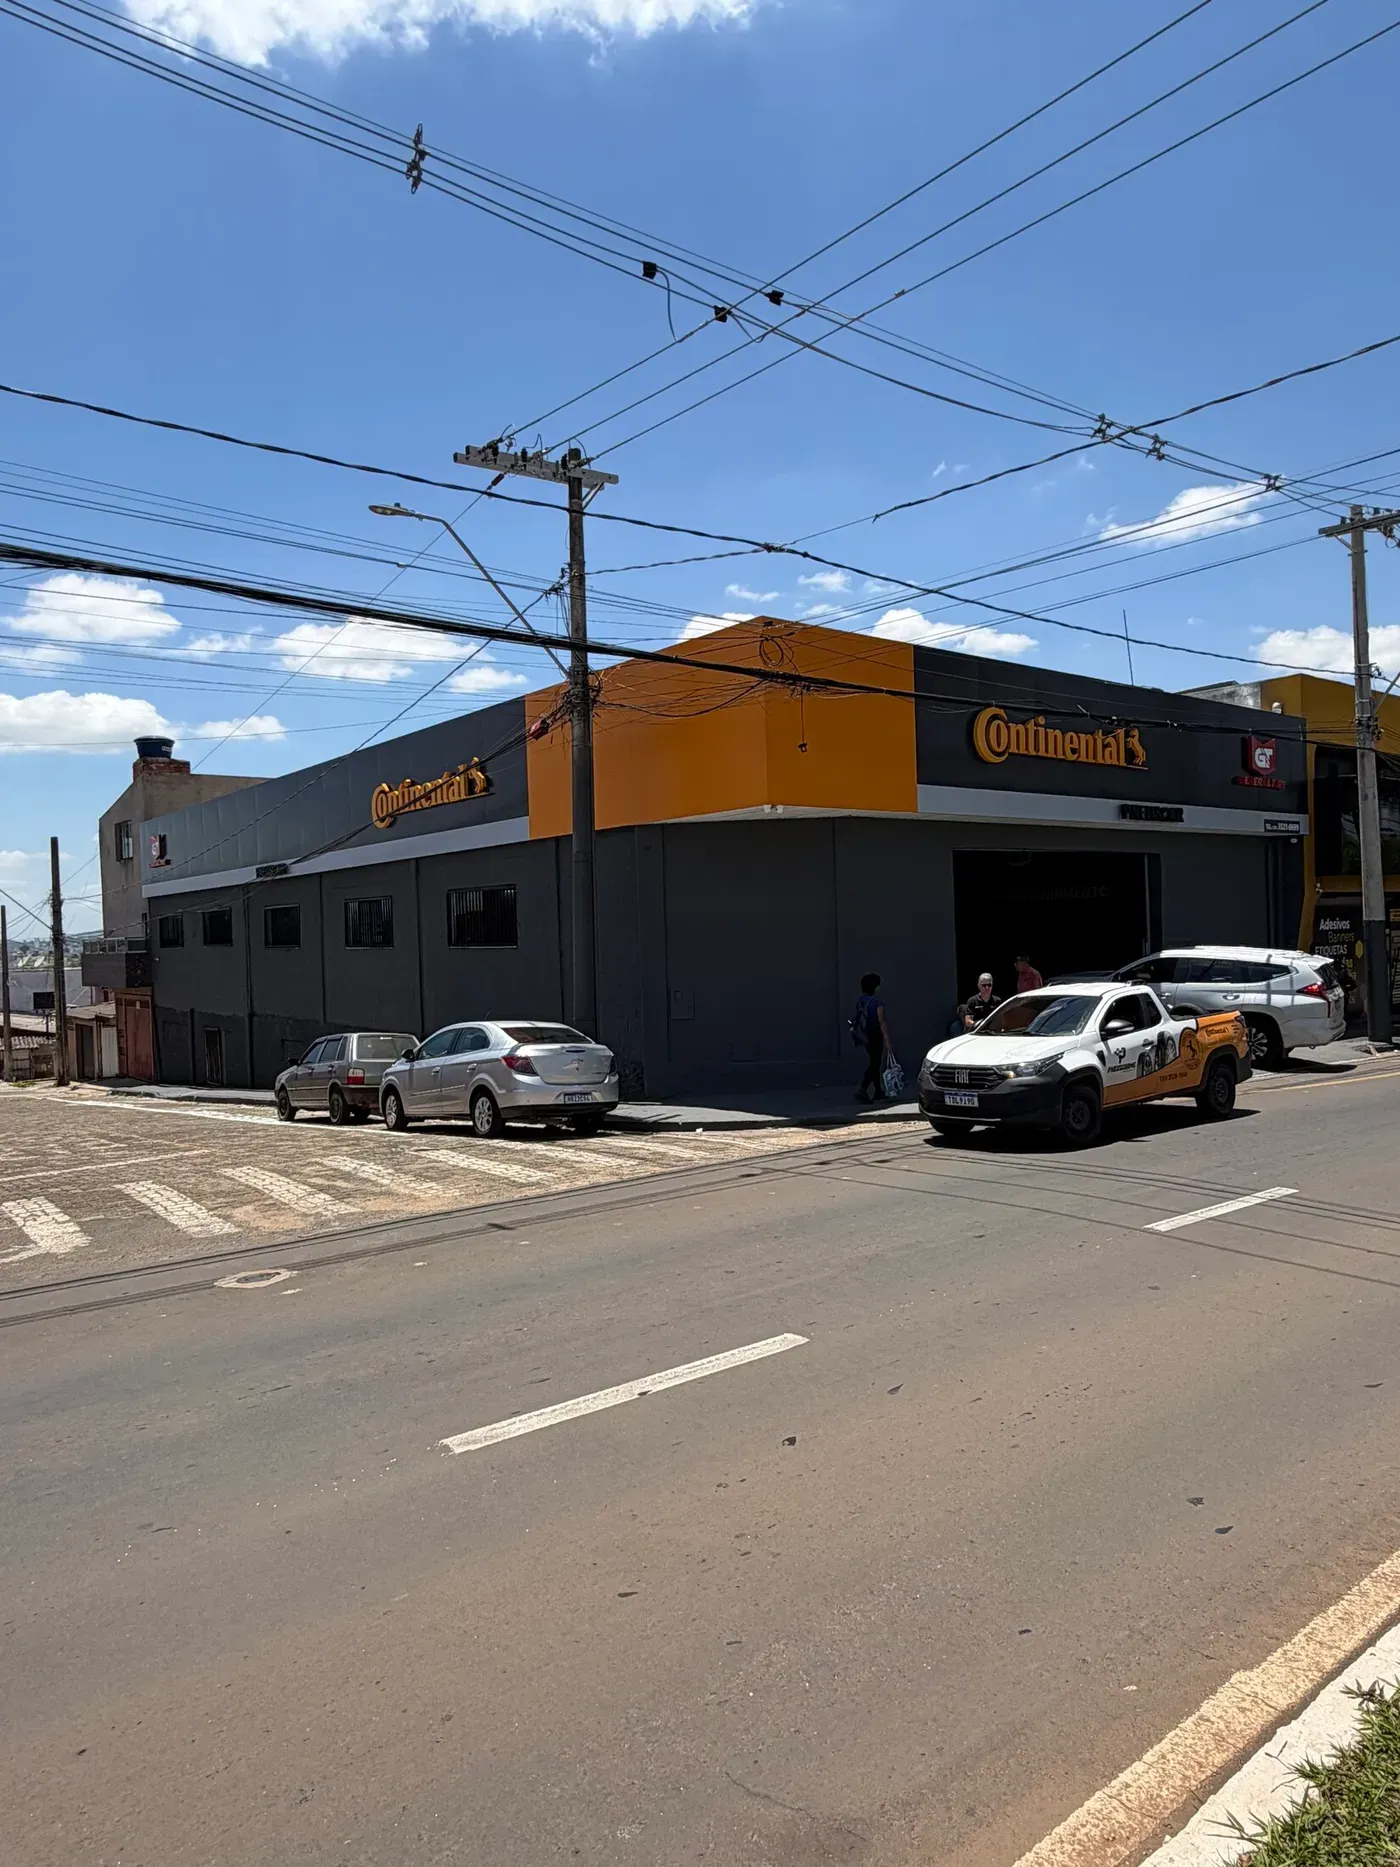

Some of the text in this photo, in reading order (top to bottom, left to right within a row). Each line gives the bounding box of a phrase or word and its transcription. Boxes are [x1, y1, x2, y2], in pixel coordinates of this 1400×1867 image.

[970, 707, 1126, 766] Continental
[371, 764, 469, 828] Continental
[1319, 918, 1351, 930] Adesivos
[1328, 932, 1355, 943] Banners
[1315, 945, 1348, 957] ETIQUETAS
[955, 1069, 970, 1084] FIAT
